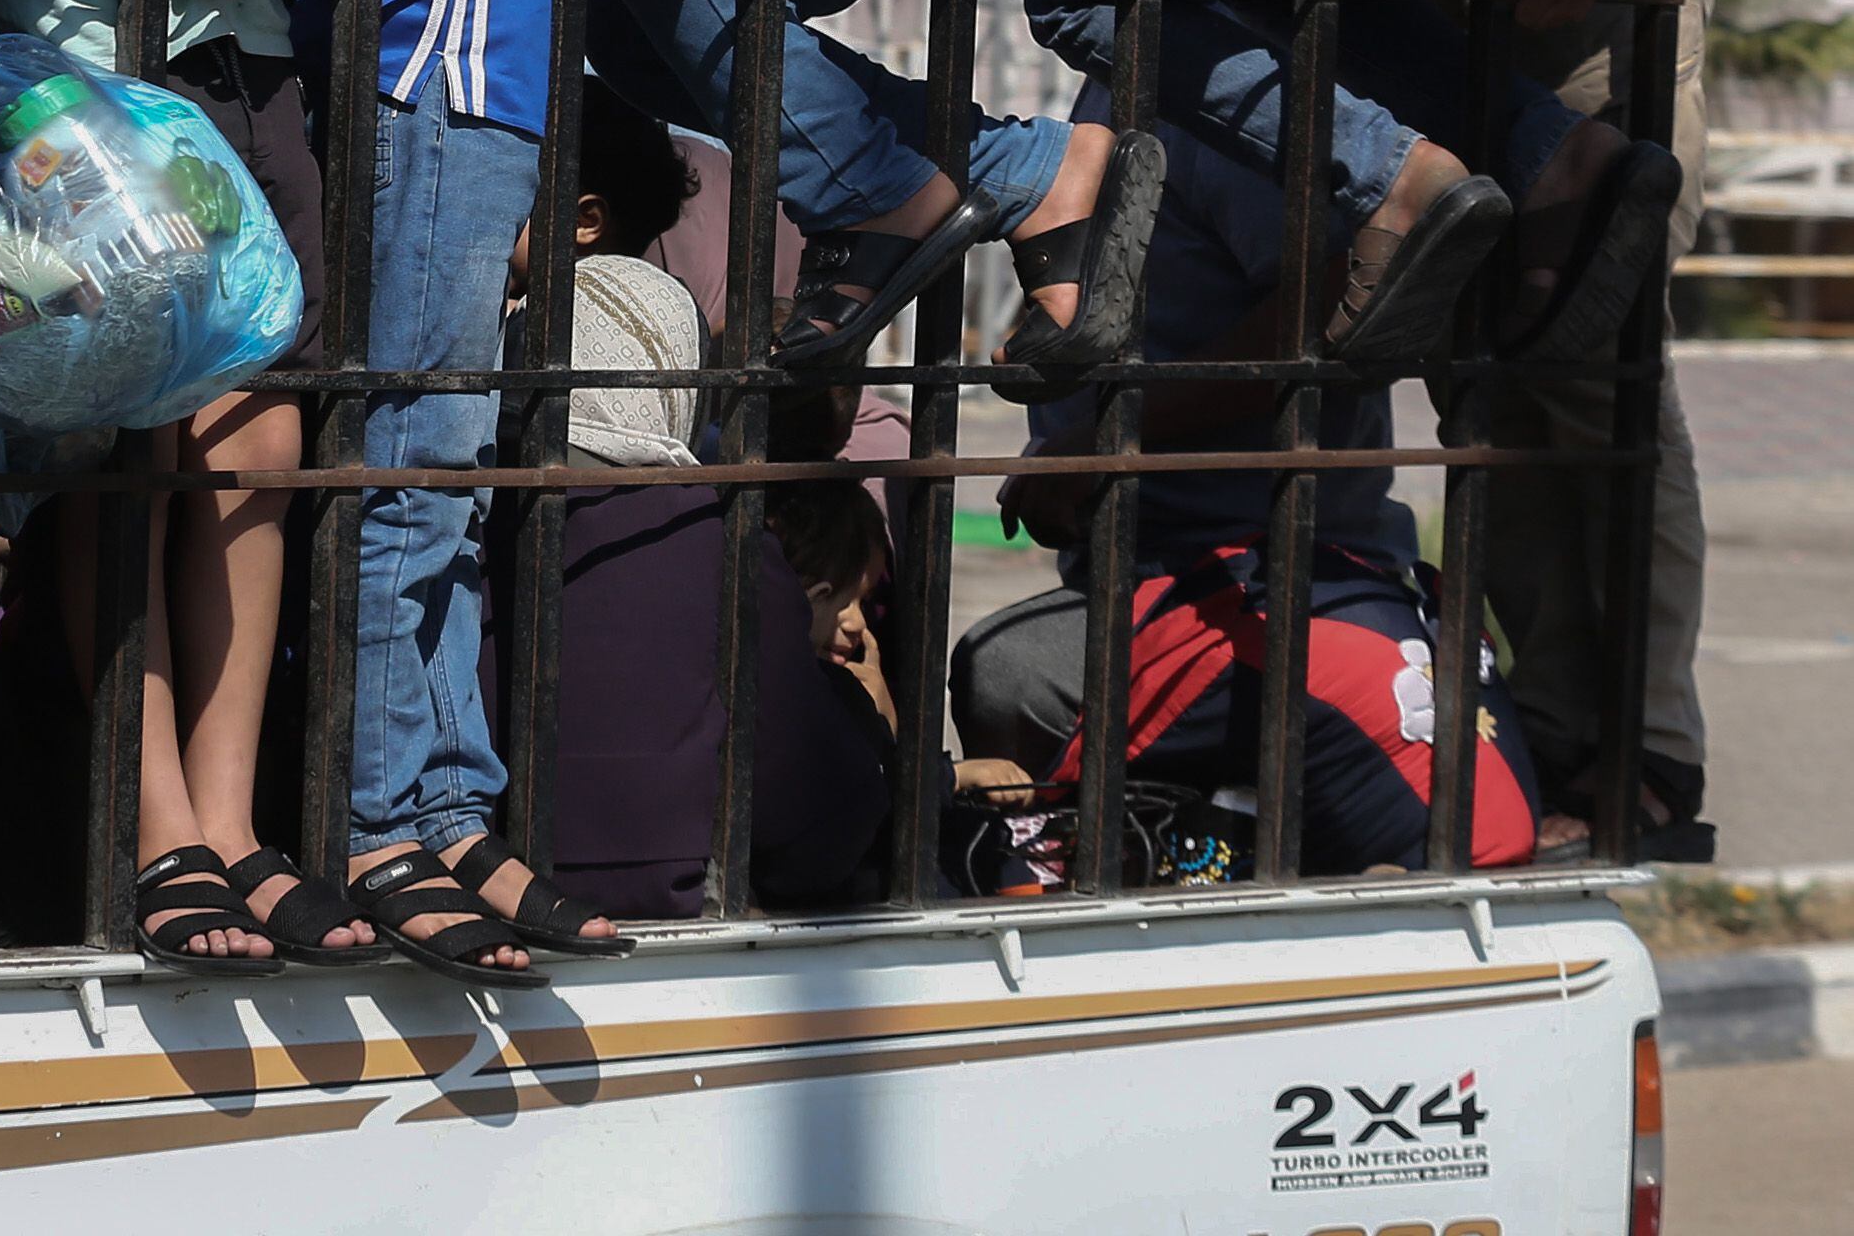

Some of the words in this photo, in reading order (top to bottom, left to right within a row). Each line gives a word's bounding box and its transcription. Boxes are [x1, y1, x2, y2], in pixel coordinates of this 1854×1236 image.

[1275, 1070, 1488, 1150] 2X4
[1271, 1154, 1341, 1173] TURBO
[1347, 1143, 1489, 1168] INTERCOOLER
